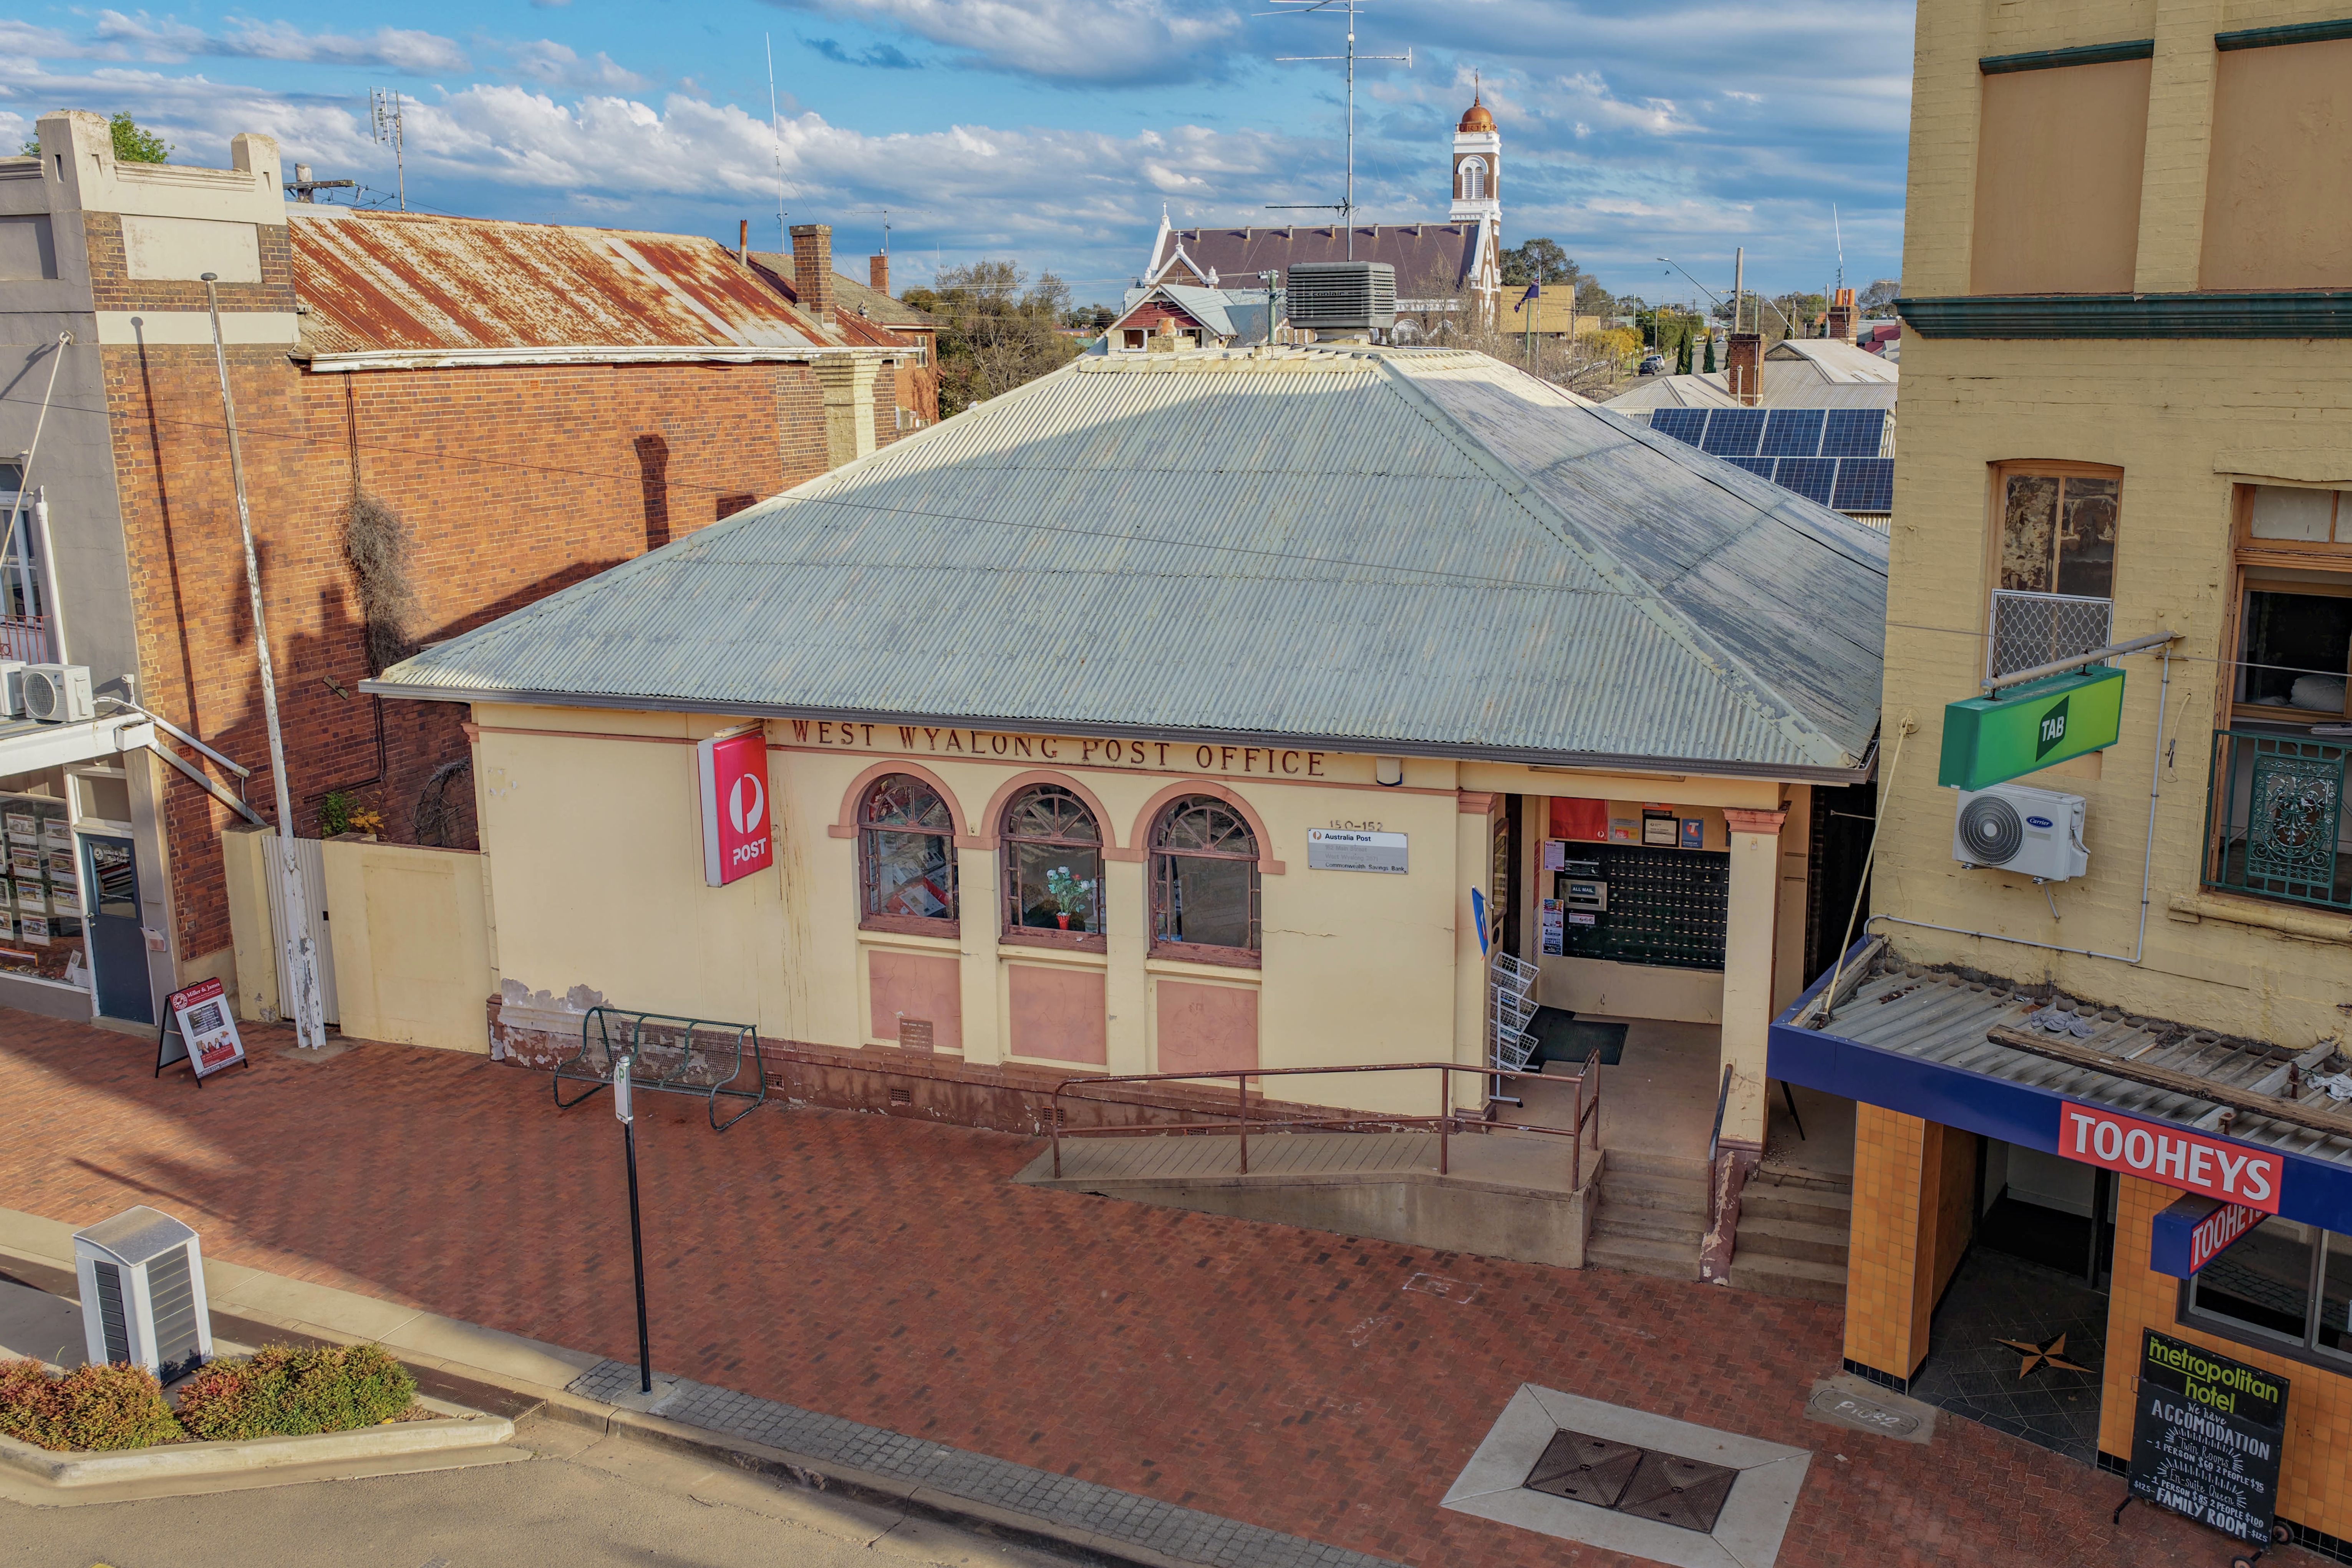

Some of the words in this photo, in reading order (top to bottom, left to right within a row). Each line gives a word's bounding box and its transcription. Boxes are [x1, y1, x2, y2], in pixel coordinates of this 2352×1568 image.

[792, 720, 874, 747] WEST
[898, 726, 1058, 758] WYALONG
[1082, 739, 1170, 766] POST
[1196, 745, 1324, 776] OFFICE
[2042, 716, 2065, 742] TAB
[733, 837, 766, 866] POST
[186, 990, 201, 998] Miller
[207, 982, 220, 991] James
[2070, 1112, 2271, 1201] TOOHEYS
[2193, 1204, 2263, 1266] TOOHE
[2149, 1341, 2278, 1404] metropolitan
[2185, 1376, 2236, 1414] hotel
[2151, 1399, 2270, 1460] ACCOMODATION
[2187, 1402, 2200, 1414] We
[2203, 1407, 2227, 1425] have
[2163, 1443, 2196, 1462] PERSON
[2197, 1455, 2213, 1470] $60
[2223, 1468, 2249, 1486] PEOPLE
[2250, 1478, 2264, 1492] $95
[2178, 1436, 2199, 1455] Twin
[2202, 1445, 2229, 1467] Rooms
[2156, 1487, 2204, 1517] FAMILY
[2206, 1508, 2247, 1539] ROOM
[2161, 1479, 2190, 1498] PERSON
[2191, 1490, 2208, 1505] $85
[2210, 1499, 2216, 1507] 2
[2217, 1502, 2243, 1520] PEOPLE
[2245, 1512, 2264, 1528] $100
[2209, 1485, 2234, 1505] Queen
